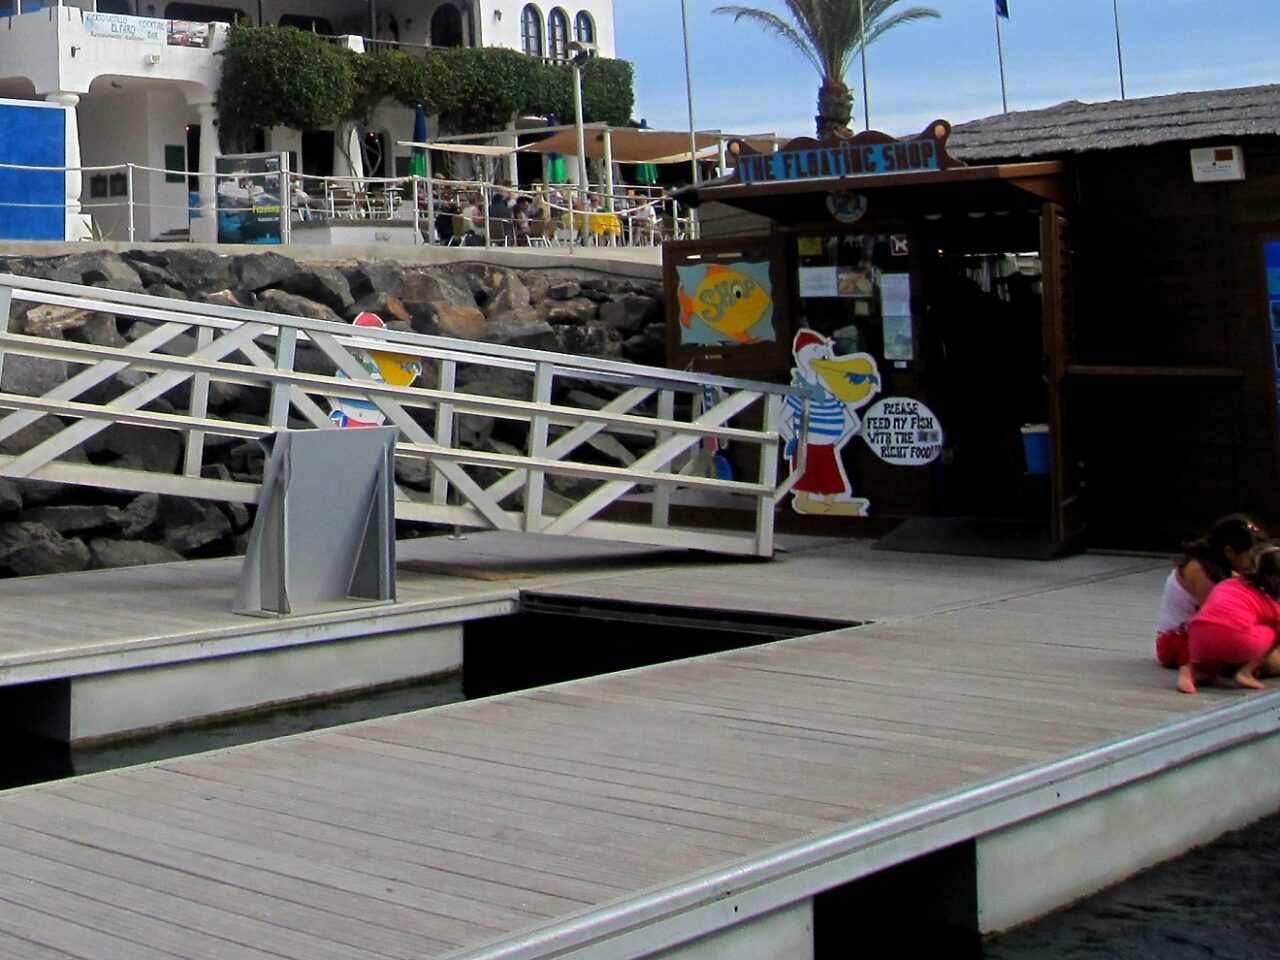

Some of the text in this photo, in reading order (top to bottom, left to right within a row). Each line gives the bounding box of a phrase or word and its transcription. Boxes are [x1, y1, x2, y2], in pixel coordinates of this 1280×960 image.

[740, 153, 776, 182] THE
[881, 141, 935, 171] SHOP
[883, 402, 919, 416] PLEASE
[867, 417, 891, 430] FEED
[893, 417, 908, 430] MY
[894, 431, 915, 444] THE
